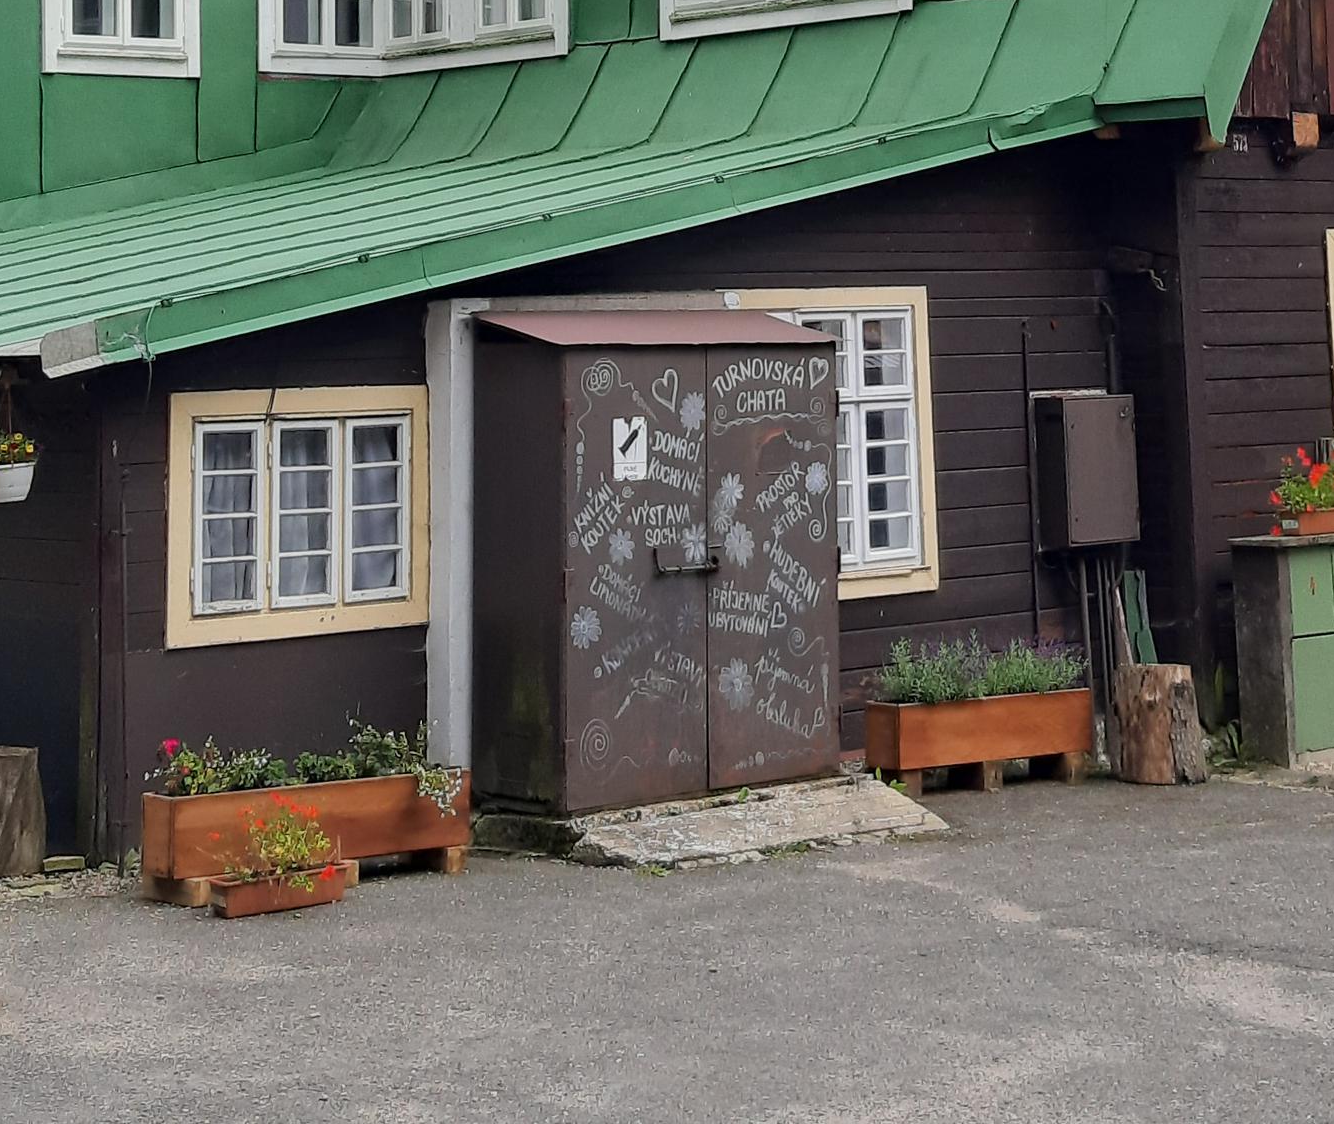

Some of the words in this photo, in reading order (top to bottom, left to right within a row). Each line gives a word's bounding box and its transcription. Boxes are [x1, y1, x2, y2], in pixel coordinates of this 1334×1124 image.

[712, 357, 806, 398] TURNOVSKÁ
[736, 387, 786, 413] CHATA
[651, 430, 705, 463] DOMÁCÍ
[755, 461, 806, 513] PROSTOR
[580, 495, 626, 555] KOUTEK
[631, 499, 691, 526] VÝSTAVA
[645, 526, 677, 547] SOCH
[766, 569, 802, 613] KOUTEK
[769, 539, 827, 608] HUDEBNÍ
